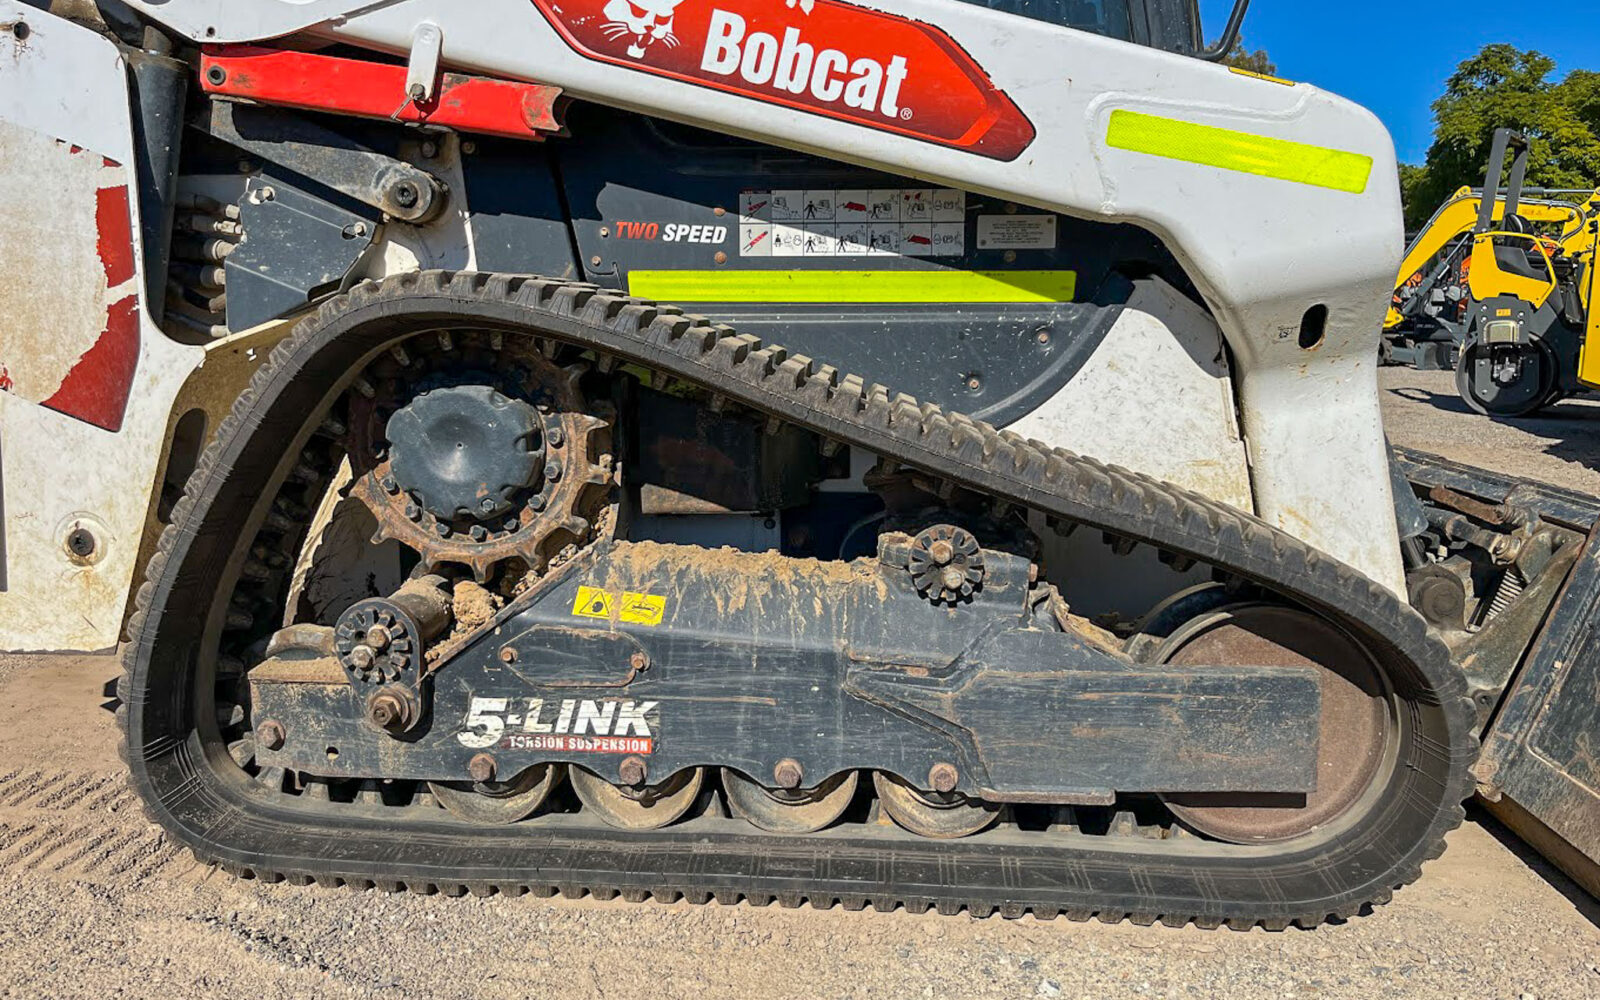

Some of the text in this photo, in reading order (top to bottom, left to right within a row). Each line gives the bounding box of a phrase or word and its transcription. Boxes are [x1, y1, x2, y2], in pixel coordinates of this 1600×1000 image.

[700, 9, 907, 118] Bobcat
[615, 221, 727, 244] TWO SPEED
[457, 697, 659, 749] 5-LINK
[509, 735, 649, 752] TORSION SUSPENSION
